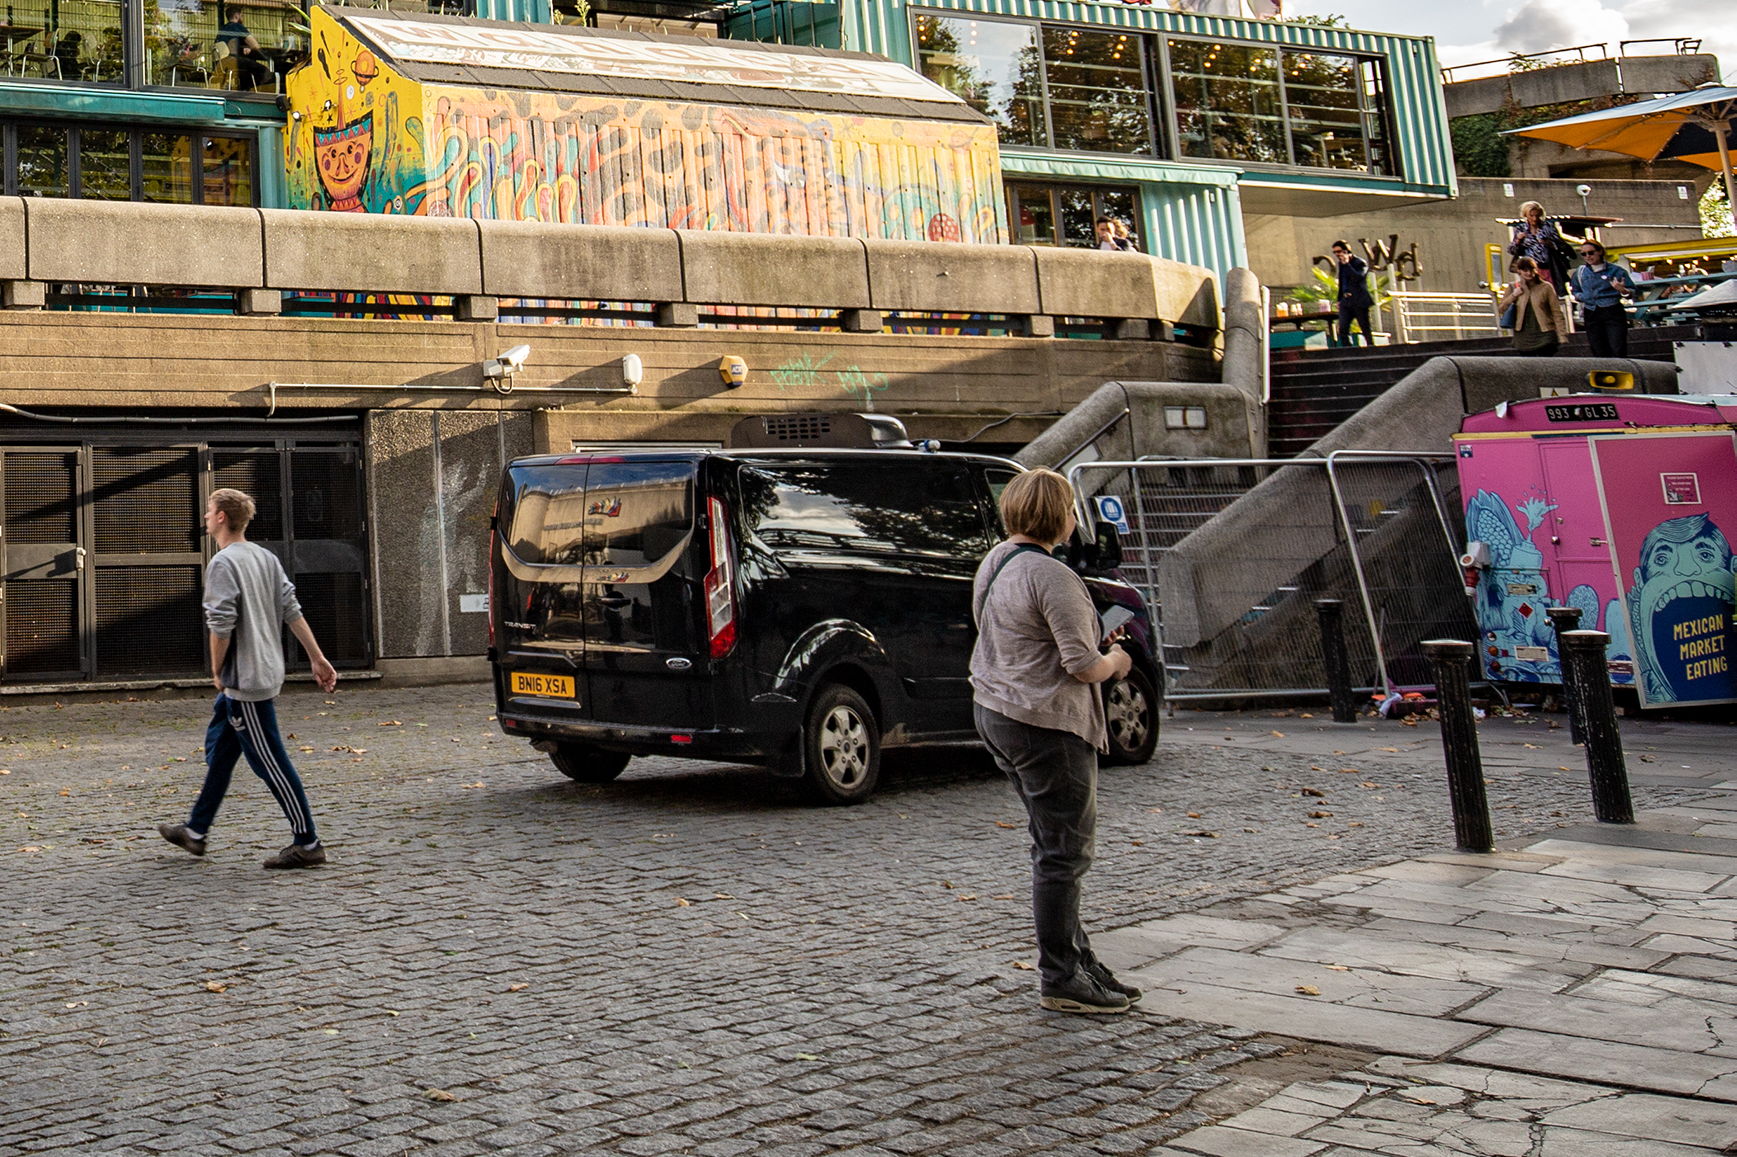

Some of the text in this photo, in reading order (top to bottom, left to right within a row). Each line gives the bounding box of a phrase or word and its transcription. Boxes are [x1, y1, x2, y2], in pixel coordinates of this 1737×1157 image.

[1547, 407, 1570, 420] 993
[1600, 405, 1616, 418] 35
[1673, 614, 1724, 641] MEXICAN
[1680, 635, 1725, 661] MARKET
[1686, 656, 1728, 680] EATING
[518, 675, 568, 694] BN16 XSA
